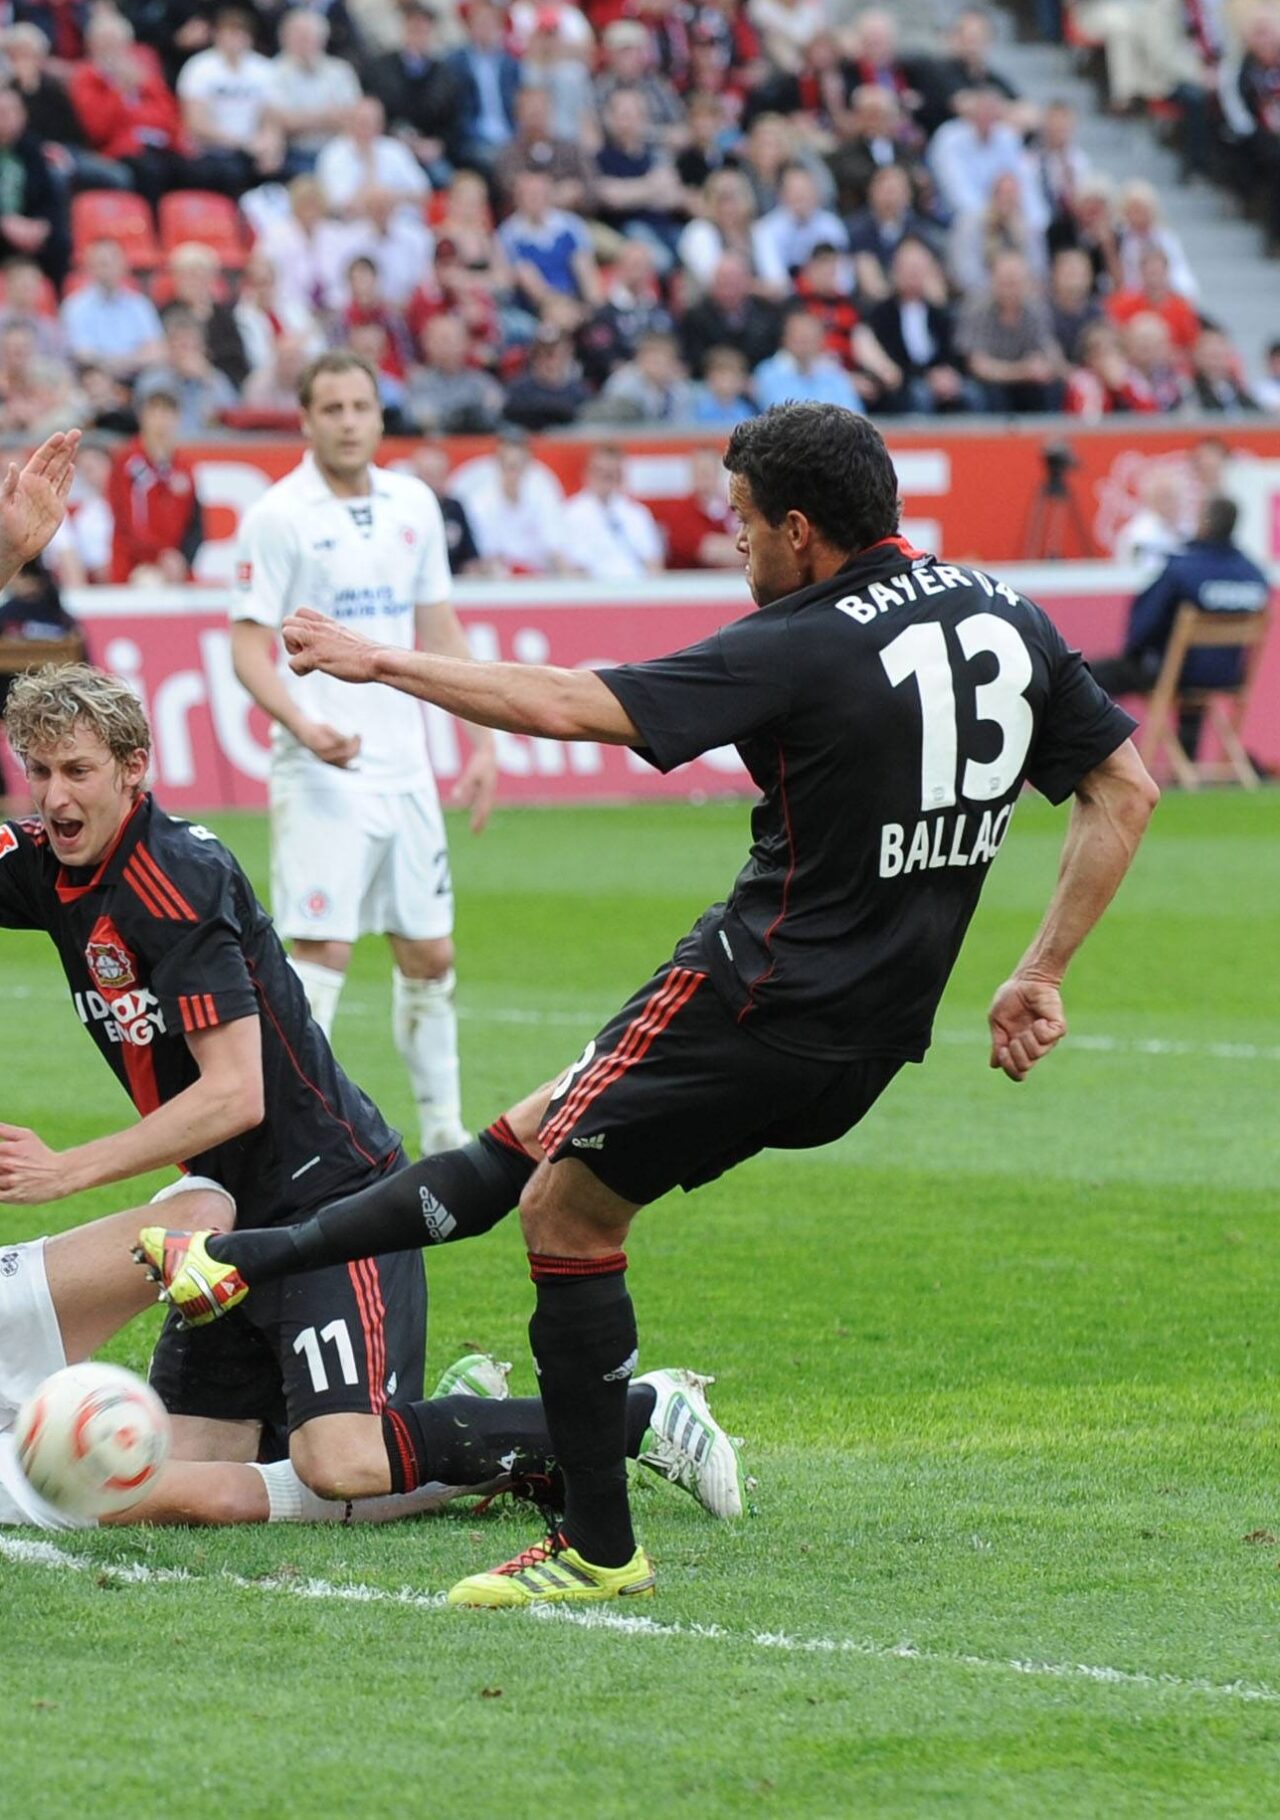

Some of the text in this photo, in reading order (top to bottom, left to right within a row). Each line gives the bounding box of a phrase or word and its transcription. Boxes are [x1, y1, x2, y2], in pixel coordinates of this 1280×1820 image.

[835, 566, 973, 625] BAYER
[879, 612, 1034, 812] 13
[879, 803, 1013, 879] BALLAC
[292, 1319, 359, 1393] 11
